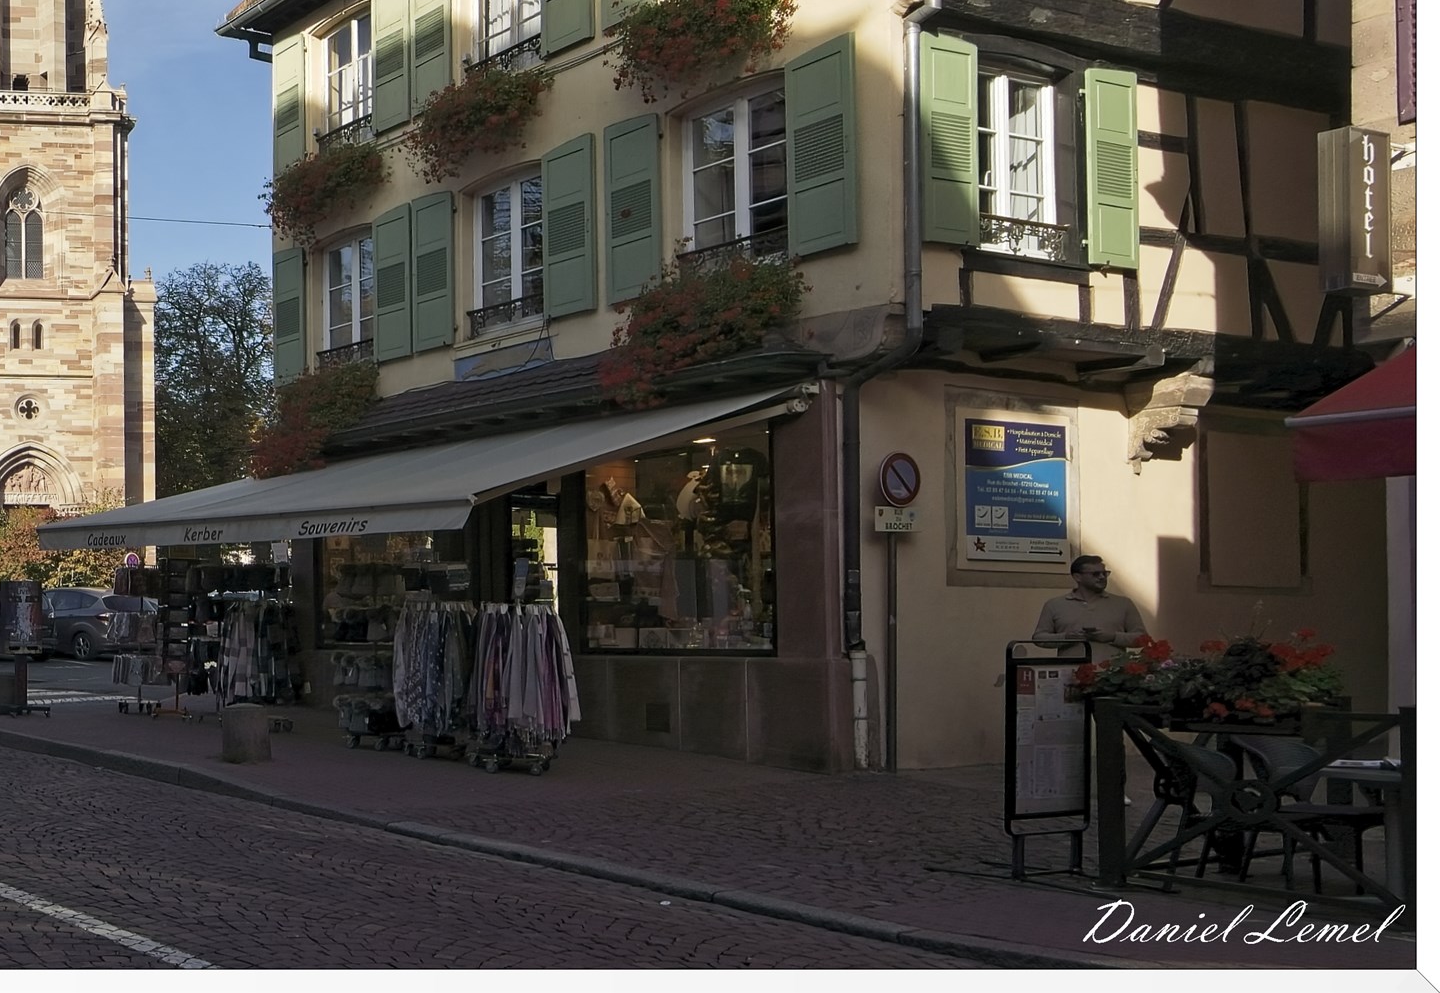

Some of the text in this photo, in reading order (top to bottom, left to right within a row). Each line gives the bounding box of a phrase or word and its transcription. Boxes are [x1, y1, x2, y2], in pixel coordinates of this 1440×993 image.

[1362, 134, 1375, 259] hotel
[87, 517, 369, 547] Cadeaux Kerber Souvenirs
